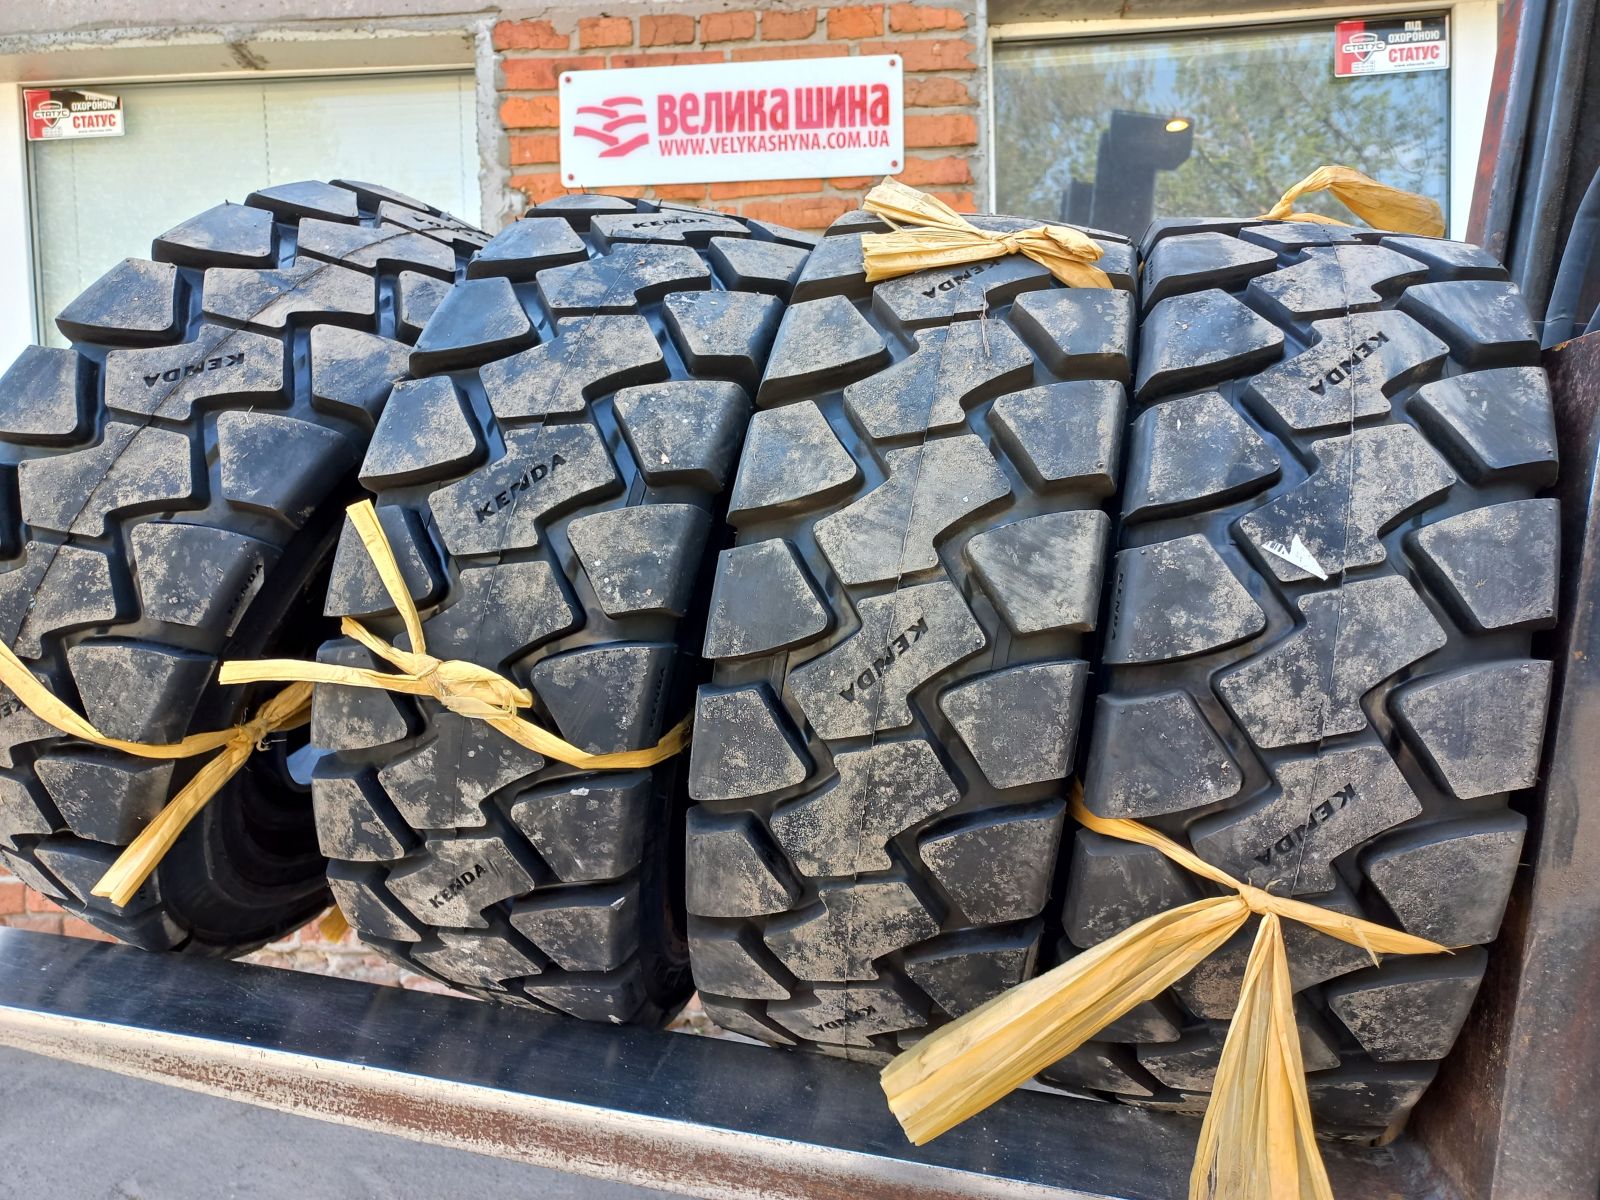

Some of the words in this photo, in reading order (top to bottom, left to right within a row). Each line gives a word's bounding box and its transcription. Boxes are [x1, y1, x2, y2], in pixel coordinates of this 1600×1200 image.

[1344, 42, 1385, 52] СТАТУС
[1388, 30, 1440, 43] ОХОРОНОЮ
[1388, 45, 1440, 63] СТАТУС
[34, 110, 69, 119] СТАТУС
[71, 100, 116, 112] ОХОРОНОЮ
[72, 114, 116, 129] СТАТУС
[659, 130, 890, 157] WWW.VELYKASHYNA.COM.UA
[143, 353, 245, 388] KENDA
[1308, 331, 1390, 397] KENDA
[474, 453, 567, 524] KENDA
[839, 617, 929, 703] KENDA
[1254, 783, 1356, 867] KENDA
[429, 864, 487, 909] KENDA
